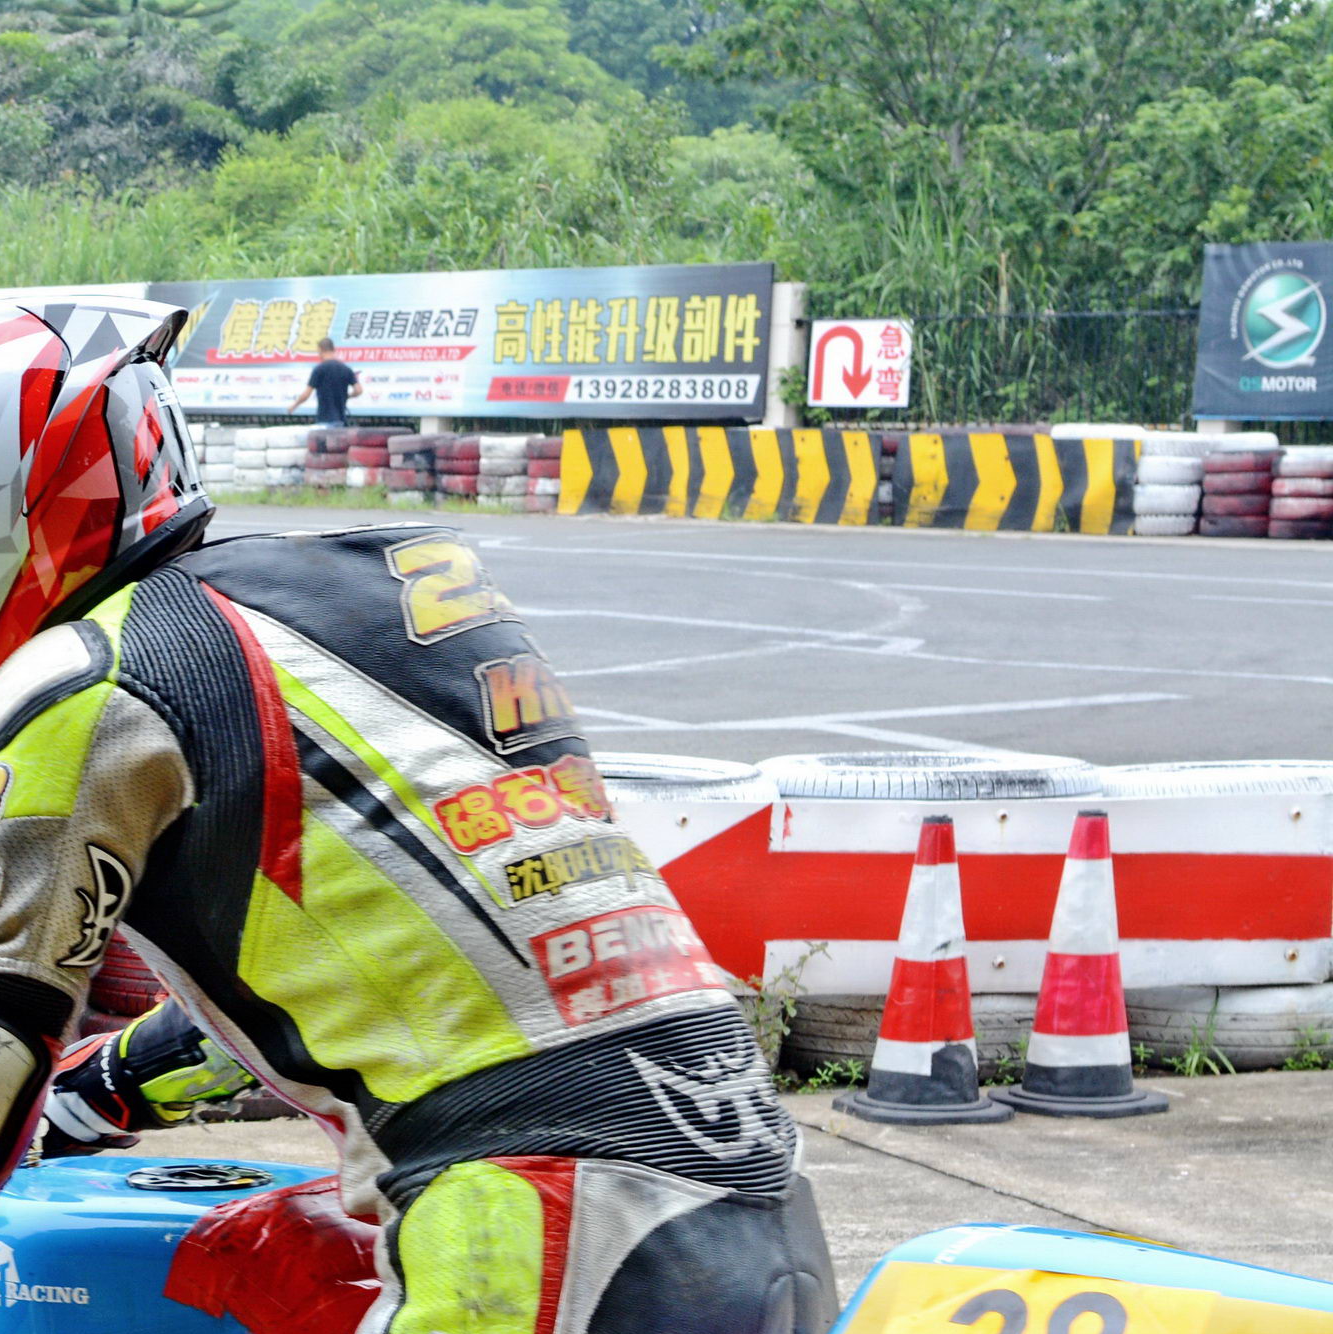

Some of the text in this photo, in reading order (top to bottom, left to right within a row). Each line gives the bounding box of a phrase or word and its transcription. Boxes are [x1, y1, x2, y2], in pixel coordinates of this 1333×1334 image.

[344, 308, 479, 340] 貿易有限公司
[494, 294, 761, 363] 高性能升级部件
[574, 379, 749, 399] 13928283808
[6, 1281, 90, 1304] RACING
